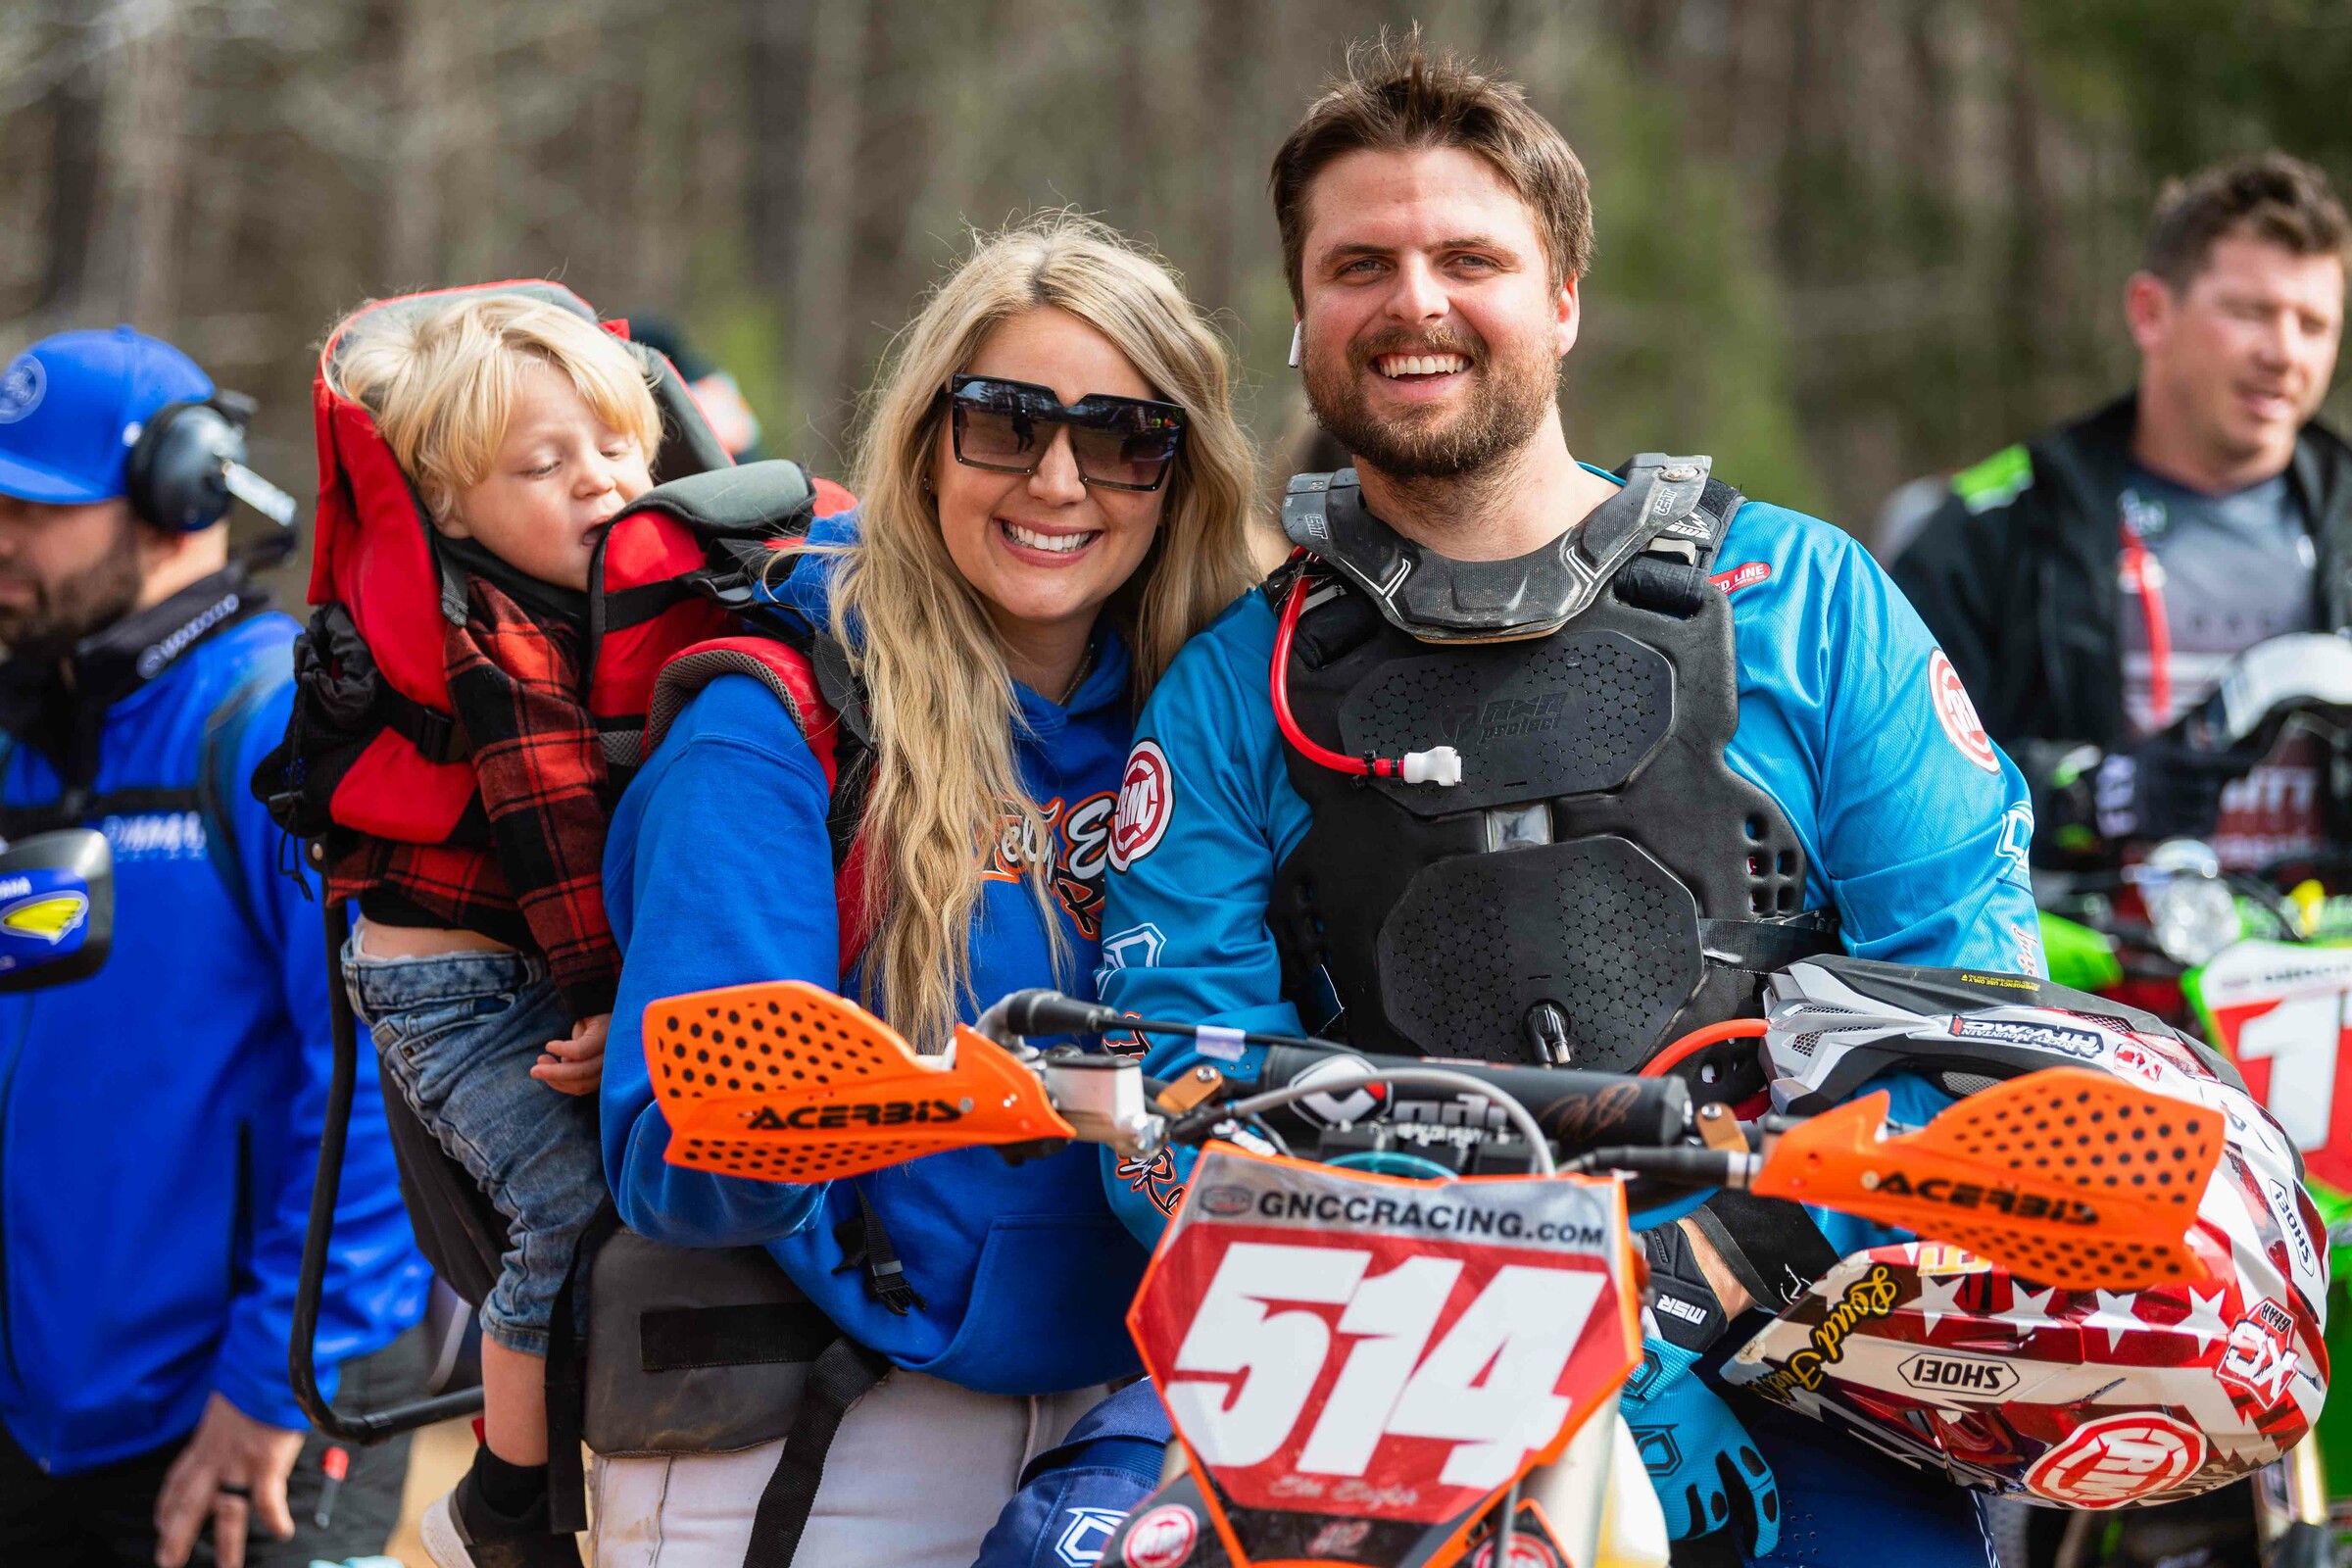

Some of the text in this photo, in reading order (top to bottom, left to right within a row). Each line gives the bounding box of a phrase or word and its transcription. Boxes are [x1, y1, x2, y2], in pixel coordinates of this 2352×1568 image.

[1735, 564, 1764, 582] LINE
[1962, 1029, 2076, 1052] ROCKY MOUNTAIN
[747, 1100, 961, 1130] ACERBIS
[1258, 1190, 1605, 1247] GNCCRACING.COM
[1873, 1172, 2099, 1226] ACERBIS
[2275, 1191, 2312, 1264] SHOEI
[1656, 1294, 1708, 1325] MSR
[1815, 1266, 1897, 1361] Loud
[2260, 1301, 2292, 1334] GEAR
[1166, 1241, 1607, 1491] 514
[1913, 1358, 2004, 1390] SHOEI
[2224, 1319, 2300, 1401] XC
